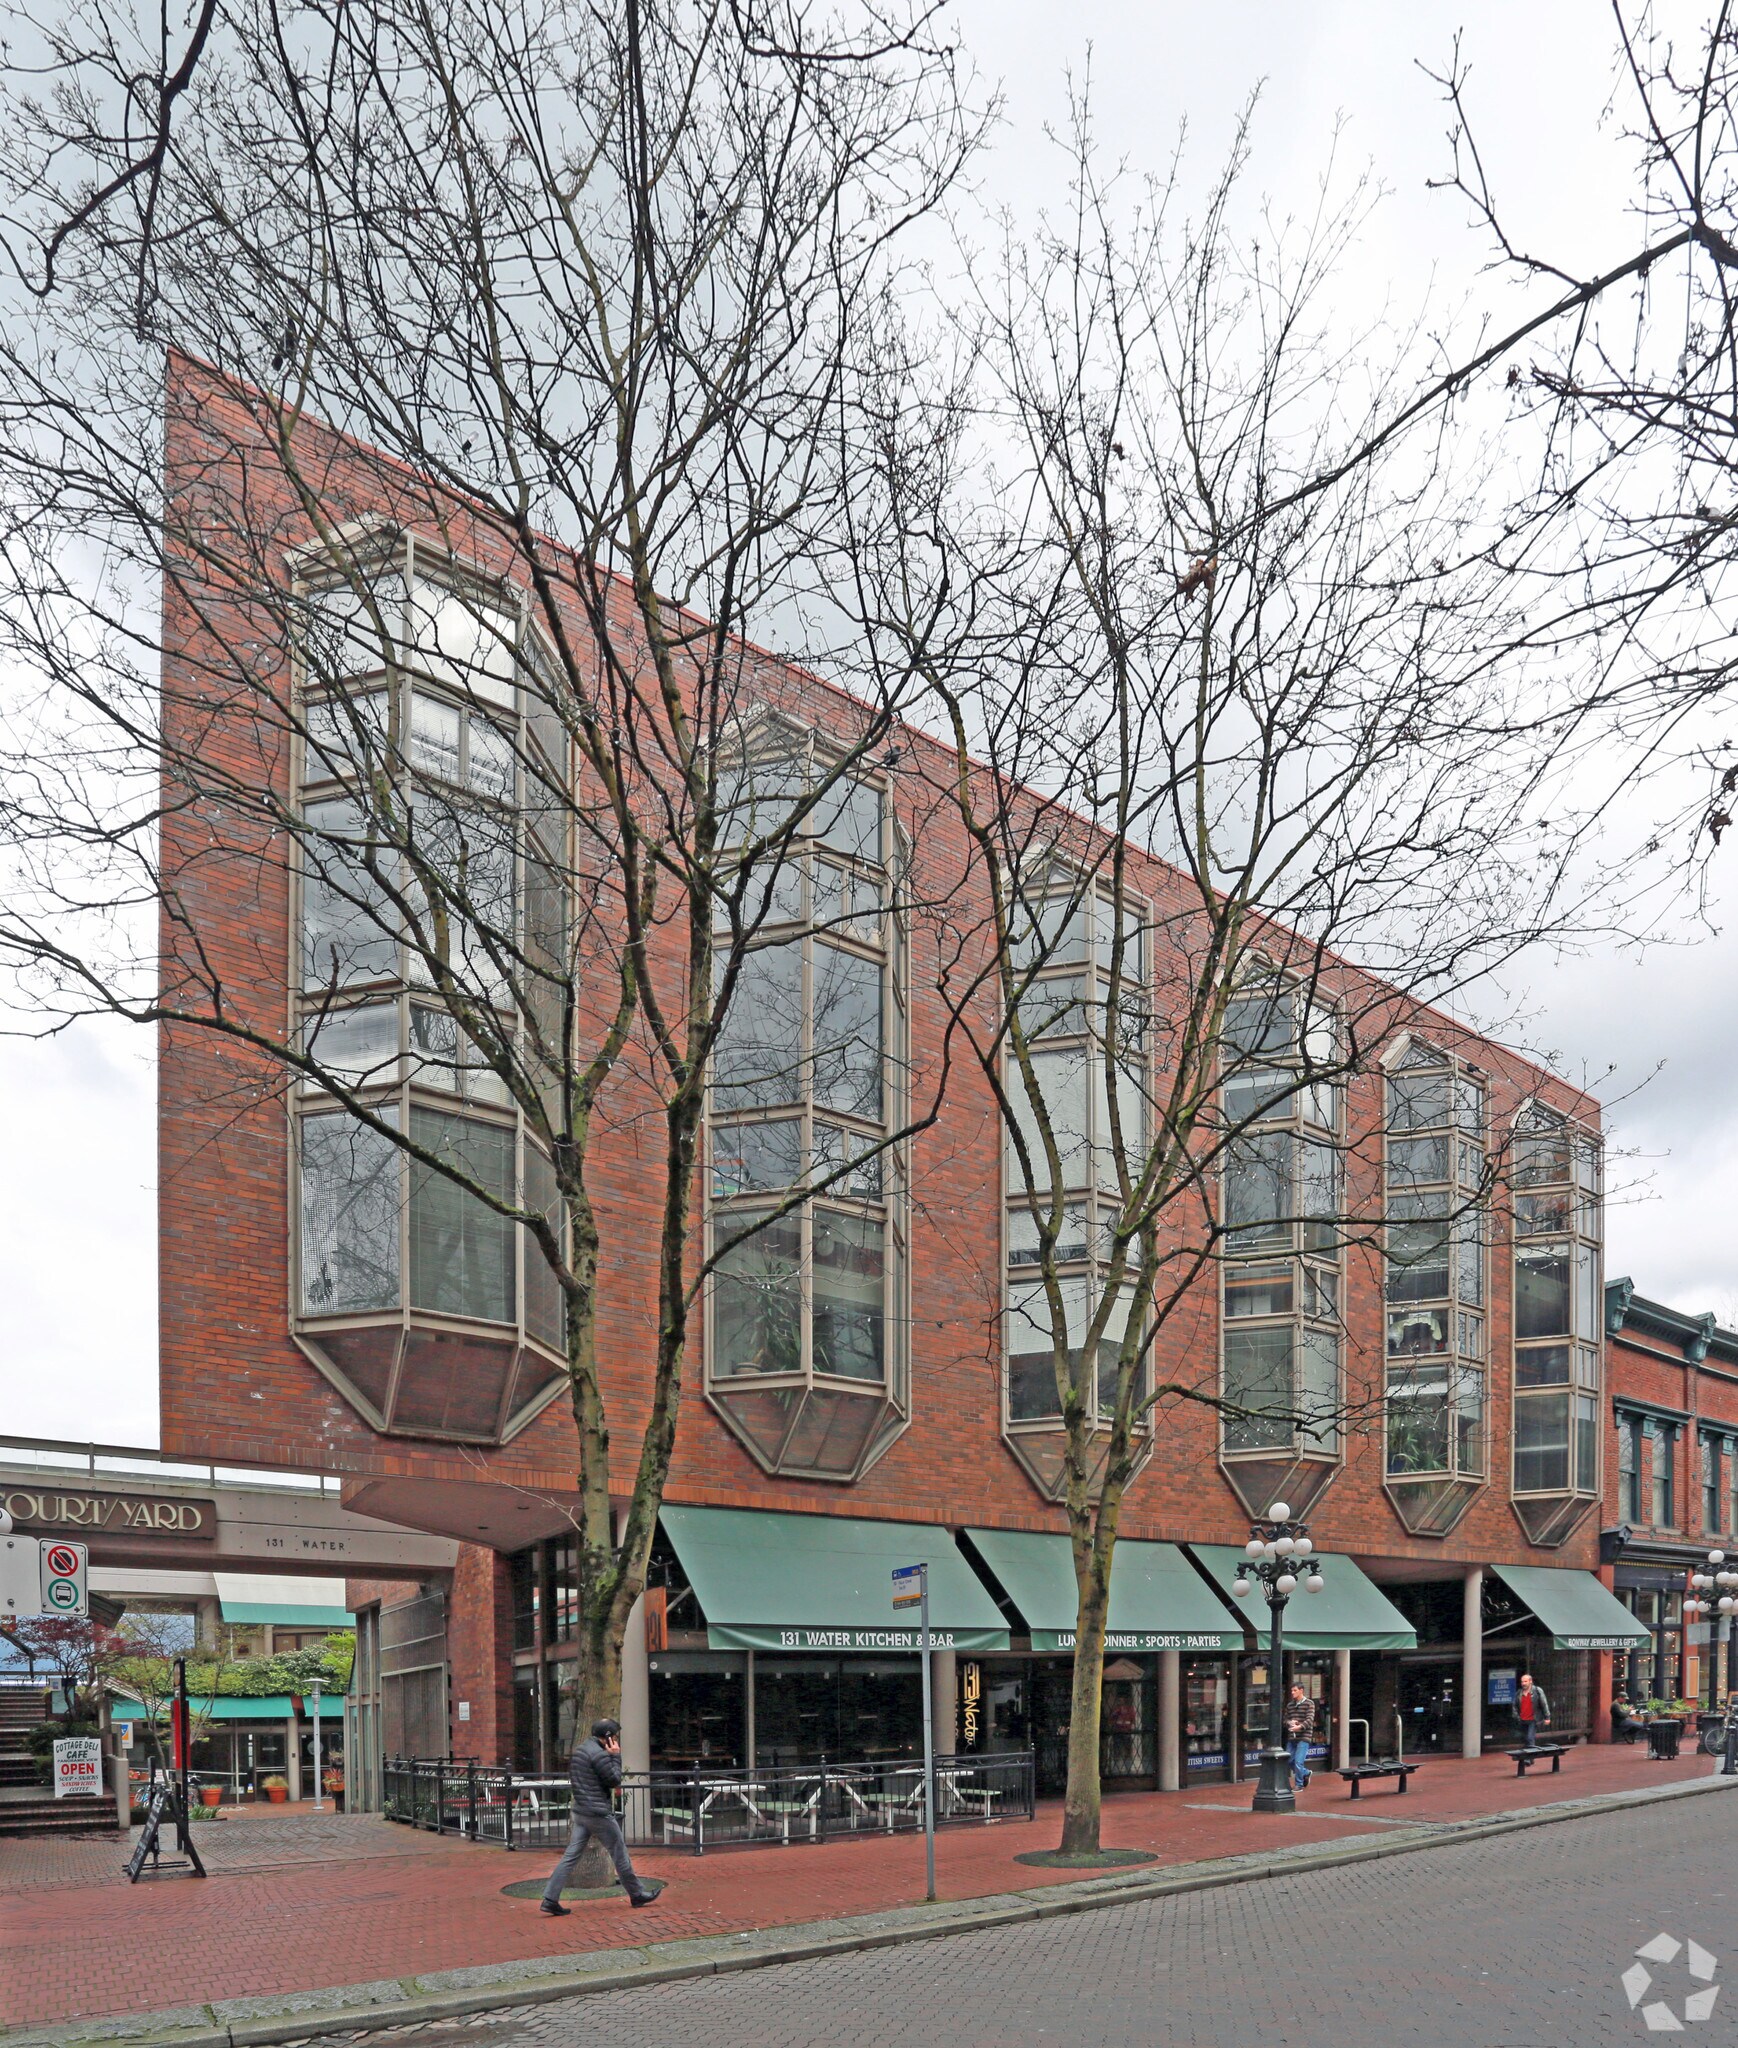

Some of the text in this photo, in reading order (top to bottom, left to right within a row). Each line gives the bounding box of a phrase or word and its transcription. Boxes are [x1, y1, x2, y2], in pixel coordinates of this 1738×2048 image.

[0, 1490, 202, 1531] OURT/YARD
[266, 1538, 345, 1551] 131 WATER
[780, 1632, 955, 1647] 131 WATER KITCHEN & BAR
[1058, 1634, 1077, 1647] LUN
[1145, 1636, 1181, 1647] SPORTS
[1187, 1636, 1221, 1647] PARTIES
[1590, 1638, 1619, 1647] JEWELLERY
[1624, 1638, 1638, 1647] GIFTS
[56, 1741, 99, 1753] COTTAGE DELI
[61, 1763, 94, 1775] OPEN
